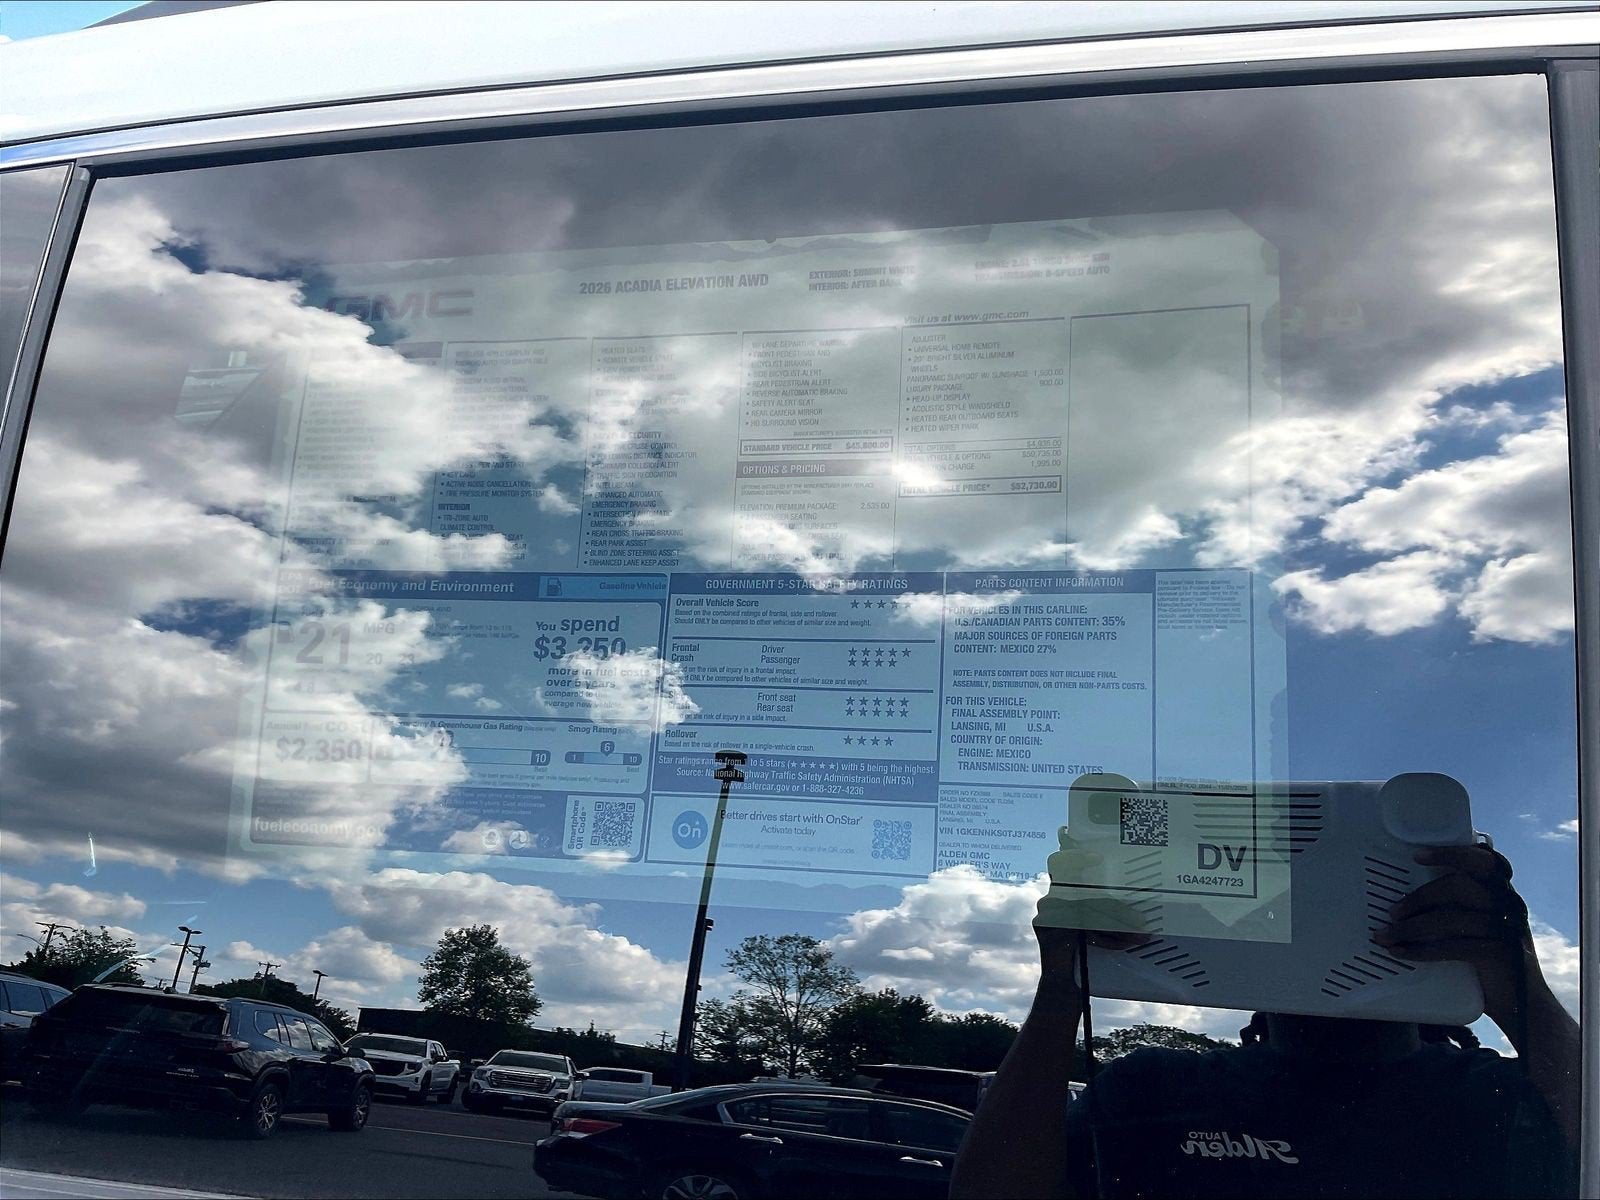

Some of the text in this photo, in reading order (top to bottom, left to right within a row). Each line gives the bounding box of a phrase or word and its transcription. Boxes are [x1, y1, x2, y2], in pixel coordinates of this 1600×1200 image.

[809, 271, 851, 279] EXTERIOR:
[580, 274, 768, 294] 2026 ACADIA ELEVATION AWD
[809, 281, 877, 291] INTERIOR: AFTER
[904, 314, 925, 323] Visit
[942, 314, 951, 322] at
[954, 311, 1029, 322] www.gmc.com
[912, 402, 1010, 412] ACOUSTIC STYLE WINDSHIELD
[782, 443, 809, 451] VEHICLE
[743, 464, 825, 474] OPTIONS & PRICING
[948, 463, 975, 471] CHARGE
[487, 480, 531, 488] CANCELLATION
[1011, 481, 1057, 491] $52,730.00
[740, 503, 774, 511] ELEVATION
[338, 579, 397, 592] Economy
[402, 580, 425, 591] and
[430, 581, 514, 592] Environment
[637, 582, 666, 590] Vehicle
[706, 579, 774, 589] GOVERNMENT
[778, 579, 815, 589] 5-STAR
[862, 579, 908, 589] RATINGS
[976, 577, 1123, 588] PARTS CONTENT INFORMATION
[676, 598, 759, 607] Overall Vehicle Score
[968, 606, 1087, 614] VEHICLES IN THIS CARLINE:
[536, 616, 619, 635] You spend
[955, 617, 1125, 626] U.S./CANADIAN PARTS CONTENT: 35%
[364, 622, 395, 634] MPG
[955, 632, 1117, 640] MAJOR SOURCES OF FOREIGN PARTS
[296, 622, 350, 664] 21
[672, 644, 785, 653] Frontal Driver
[954, 645, 1056, 653] CONTENT: MEXICO 27%
[366, 653, 383, 664] 20
[672, 654, 800, 665] Crash Passenger
[548, 667, 592, 675] more in
[585, 681, 615, 689] years
[758, 693, 796, 702] Front seat
[946, 697, 1027, 706] FOR THIS VEHICLE:
[757, 703, 793, 712] Rear seat
[952, 709, 1060, 719] FINAL ASSEMBLY POINT:
[483, 722, 497, 730] Gas
[500, 724, 523, 732] Rating
[568, 725, 590, 734] Smog
[593, 725, 617, 735] Rating
[952, 722, 1054, 732] LANSING, MI U.S.A.
[665, 730, 697, 738] Rollover
[951, 736, 992, 744] COUNTRY
[1009, 737, 1042, 745] ORIGIN:
[277, 736, 362, 763] $2,350
[604, 743, 611, 752] 6
[959, 748, 1031, 758] ENGINE: MEXICO
[535, 754, 546, 763] 10
[659, 756, 935, 774] Star ratings to 5 stars with 5 being the highest.
[958, 761, 1103, 774] TRANSMISSION: UNITED STATES
[676, 768, 914, 786] Source: National Traffic Safety Administration (NHTSA)
[723, 782, 790, 792] www.safercar.gov
[802, 784, 864, 795] 1-888-327-4236
[721, 810, 749, 820] Better
[750, 811, 777, 822] drives
[779, 812, 800, 823] start
[803, 813, 823, 824] with
[568, 800, 579, 849] Smartphone
[678, 820, 700, 839] On
[761, 825, 816, 836] Activate today
[576, 835, 584, 849] QR
[1198, 843, 1247, 871] DV
[1177, 875, 1244, 887] 1GA4247723
